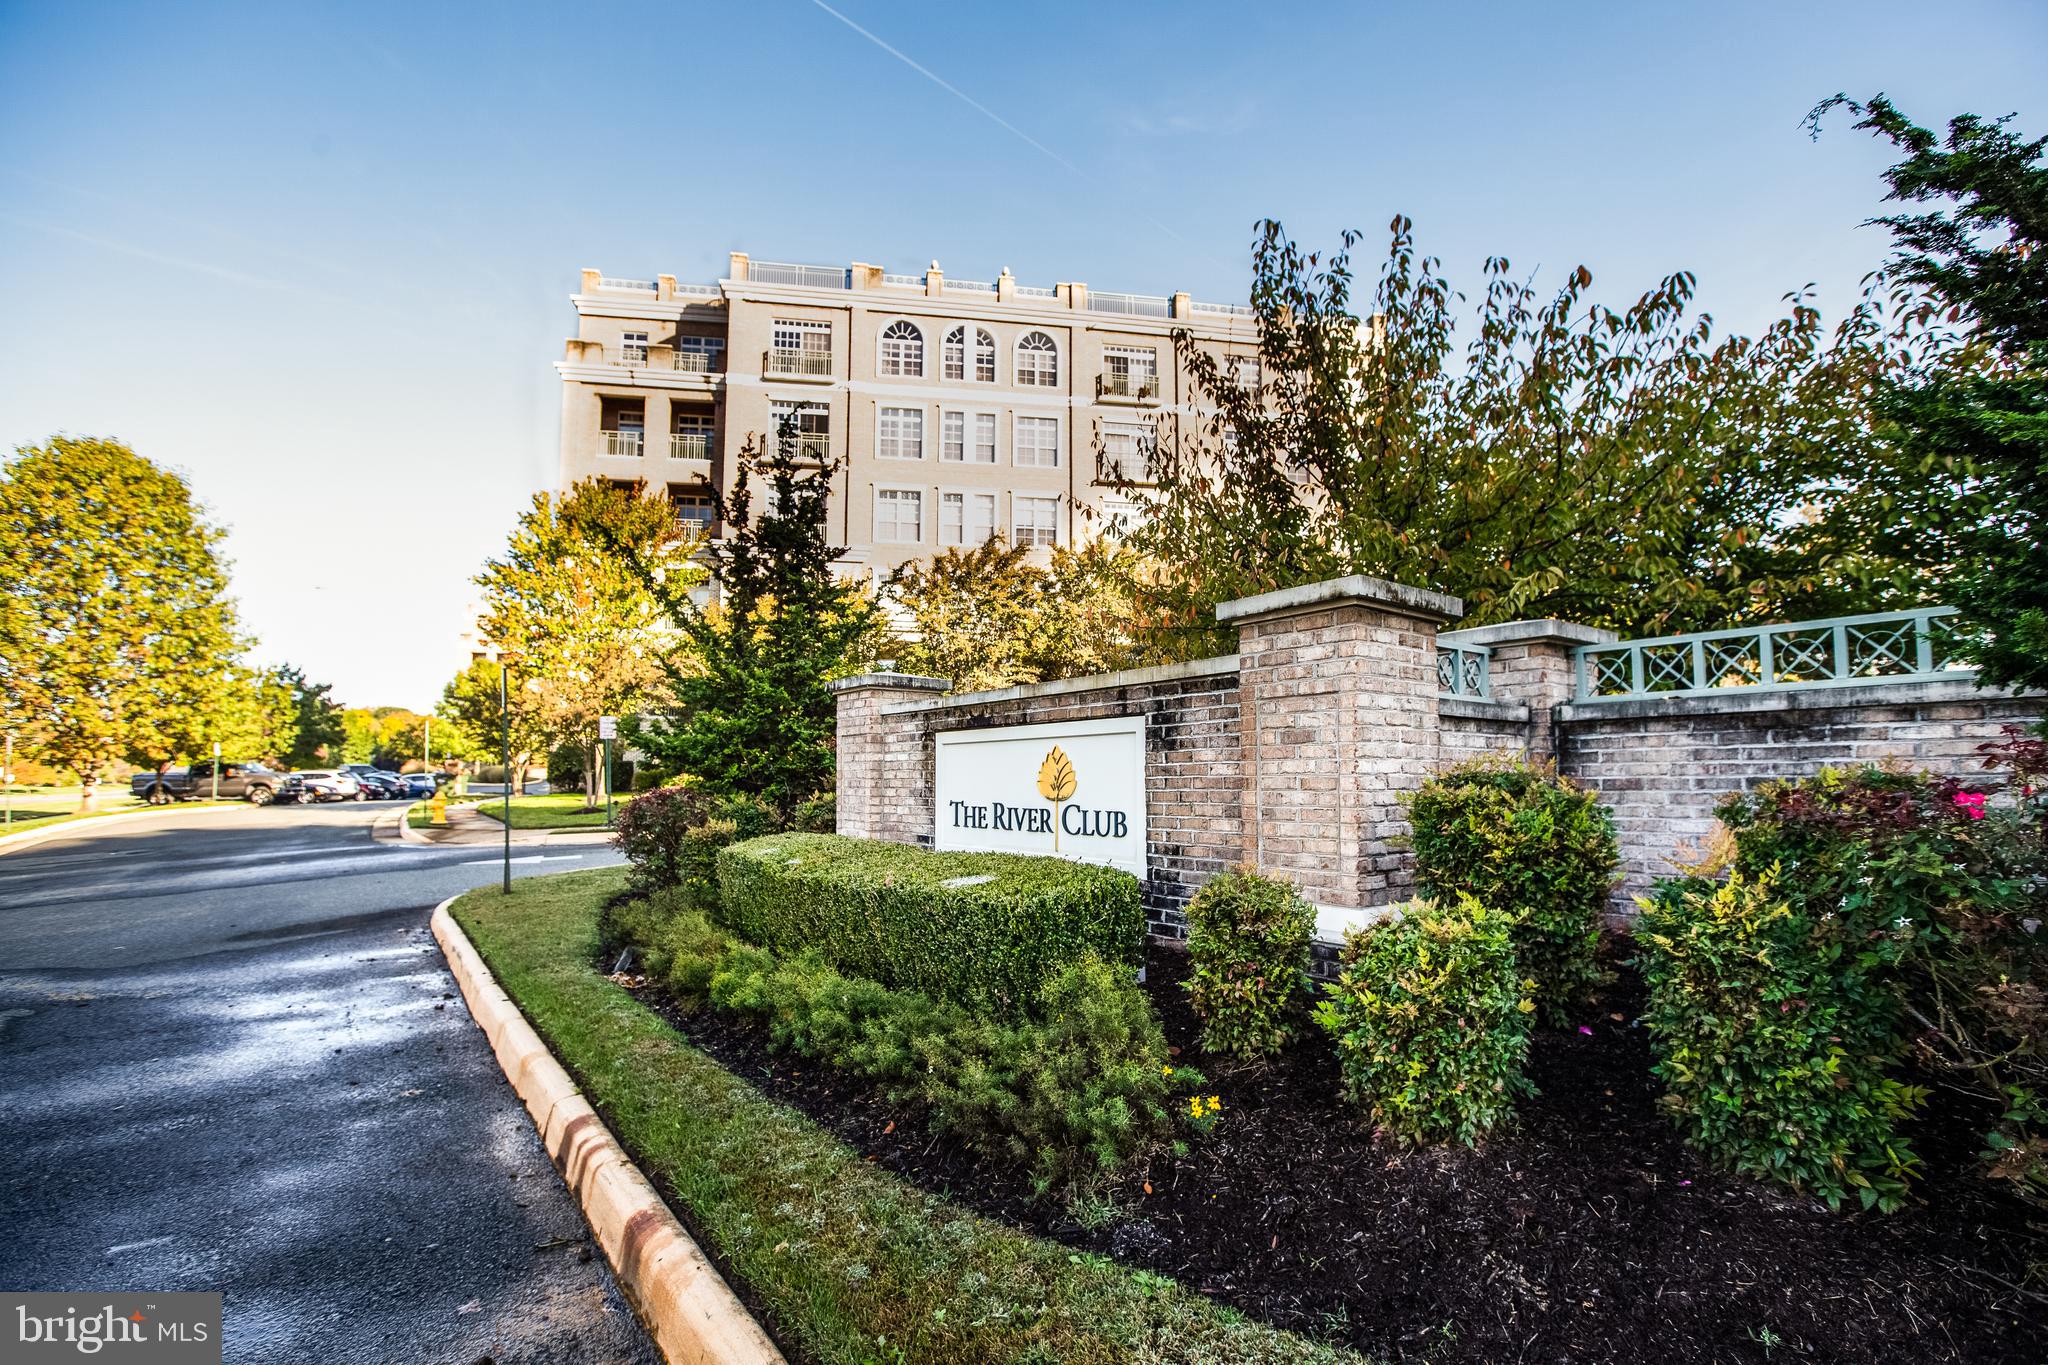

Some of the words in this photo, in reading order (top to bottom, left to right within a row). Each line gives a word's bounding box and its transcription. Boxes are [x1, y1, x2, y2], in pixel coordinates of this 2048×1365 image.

[950, 800, 988, 829] THE
[992, 802, 1054, 833] RIVER
[1061, 804, 1128, 838] CLUB
